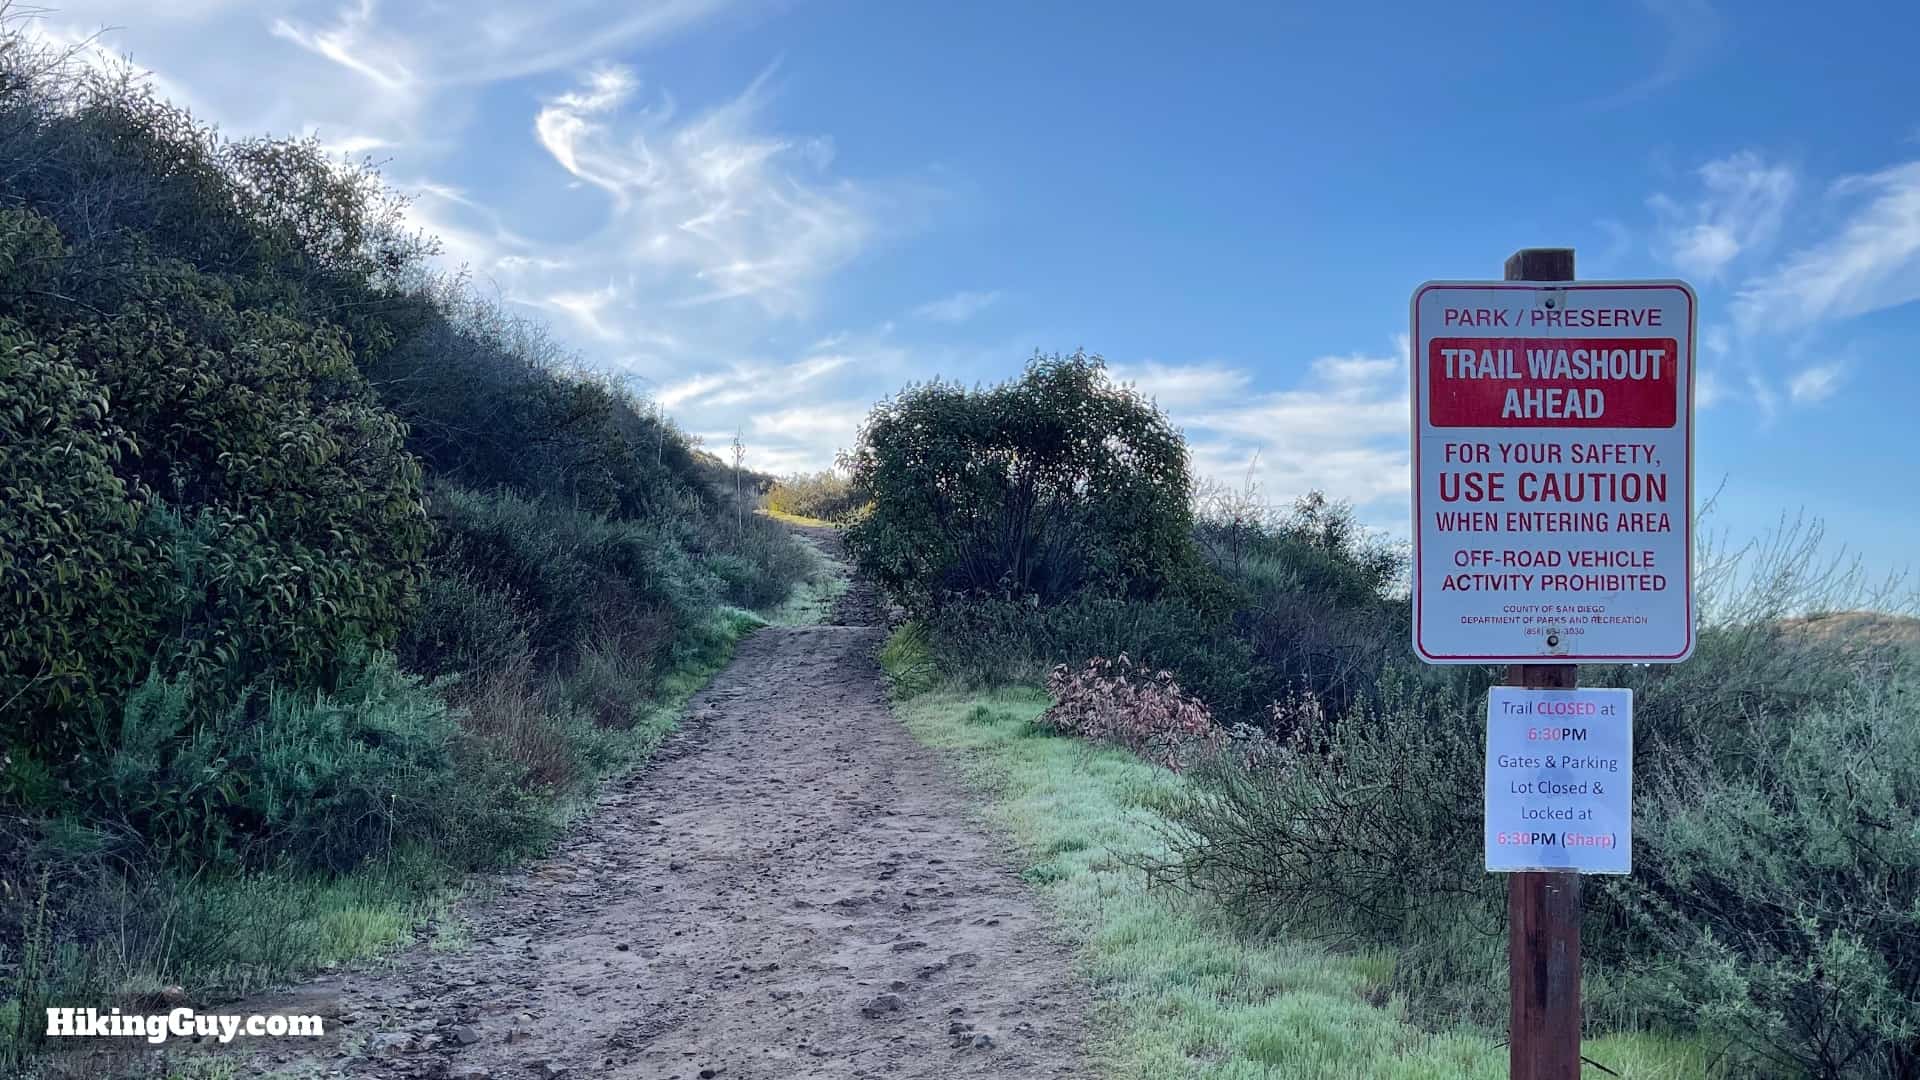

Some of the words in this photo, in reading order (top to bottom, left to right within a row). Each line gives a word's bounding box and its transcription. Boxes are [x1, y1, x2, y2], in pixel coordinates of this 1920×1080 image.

[1444, 309, 1509, 327] PARK
[1531, 309, 1663, 327] PRESERVE
[1441, 349, 1522, 379] TRAIL
[1527, 349, 1665, 379] WASHOUT
[1502, 388, 1605, 419] AHEAD
[1445, 444, 1490, 463] FOR
[1500, 444, 1562, 463] YOUR
[1571, 444, 1662, 467] SAFETY,
[1440, 472, 1505, 503] USE
[1518, 472, 1667, 503] CAUTION
[1436, 512, 1498, 532] WHEN
[1507, 512, 1608, 532] ENTERING
[1616, 512, 1671, 532] AREA
[1454, 551, 1561, 567] OFF-ROAD
[1568, 551, 1655, 567] VEHICLE
[1442, 575, 1533, 591] ACTIVITY
[1541, 575, 1666, 591] PROHIBITED
[1504, 605, 1539, 613] COUNTY
[1541, 605, 1554, 613] OF
[1556, 605, 1575, 613] SAN
[1578, 605, 1605, 613] DIEGO
[1461, 616, 1520, 624] DEPARTMENT
[1523, 616, 1535, 624] OF
[1537, 616, 1567, 624] PARKS
[1569, 616, 1588, 624] AND
[1591, 616, 1648, 624] RECREATION
[1502, 702, 1532, 715] Trail
[1537, 702, 1596, 715] CLOSED
[1601, 704, 1615, 715] at
[1528, 728, 1587, 741] 6:30PM
[1498, 755, 1540, 768] Gates
[1545, 756, 1556, 768] &
[1562, 755, 1618, 772] Parking
[1511, 782, 1533, 793] Lot
[1538, 781, 1587, 794] Closed
[1592, 782, 1604, 794] &
[1522, 807, 1573, 820] Locked
[1578, 809, 1592, 820] at
[1497, 832, 1556, 845] 6:30PM
[1562, 833, 1616, 848] (Sharp)
